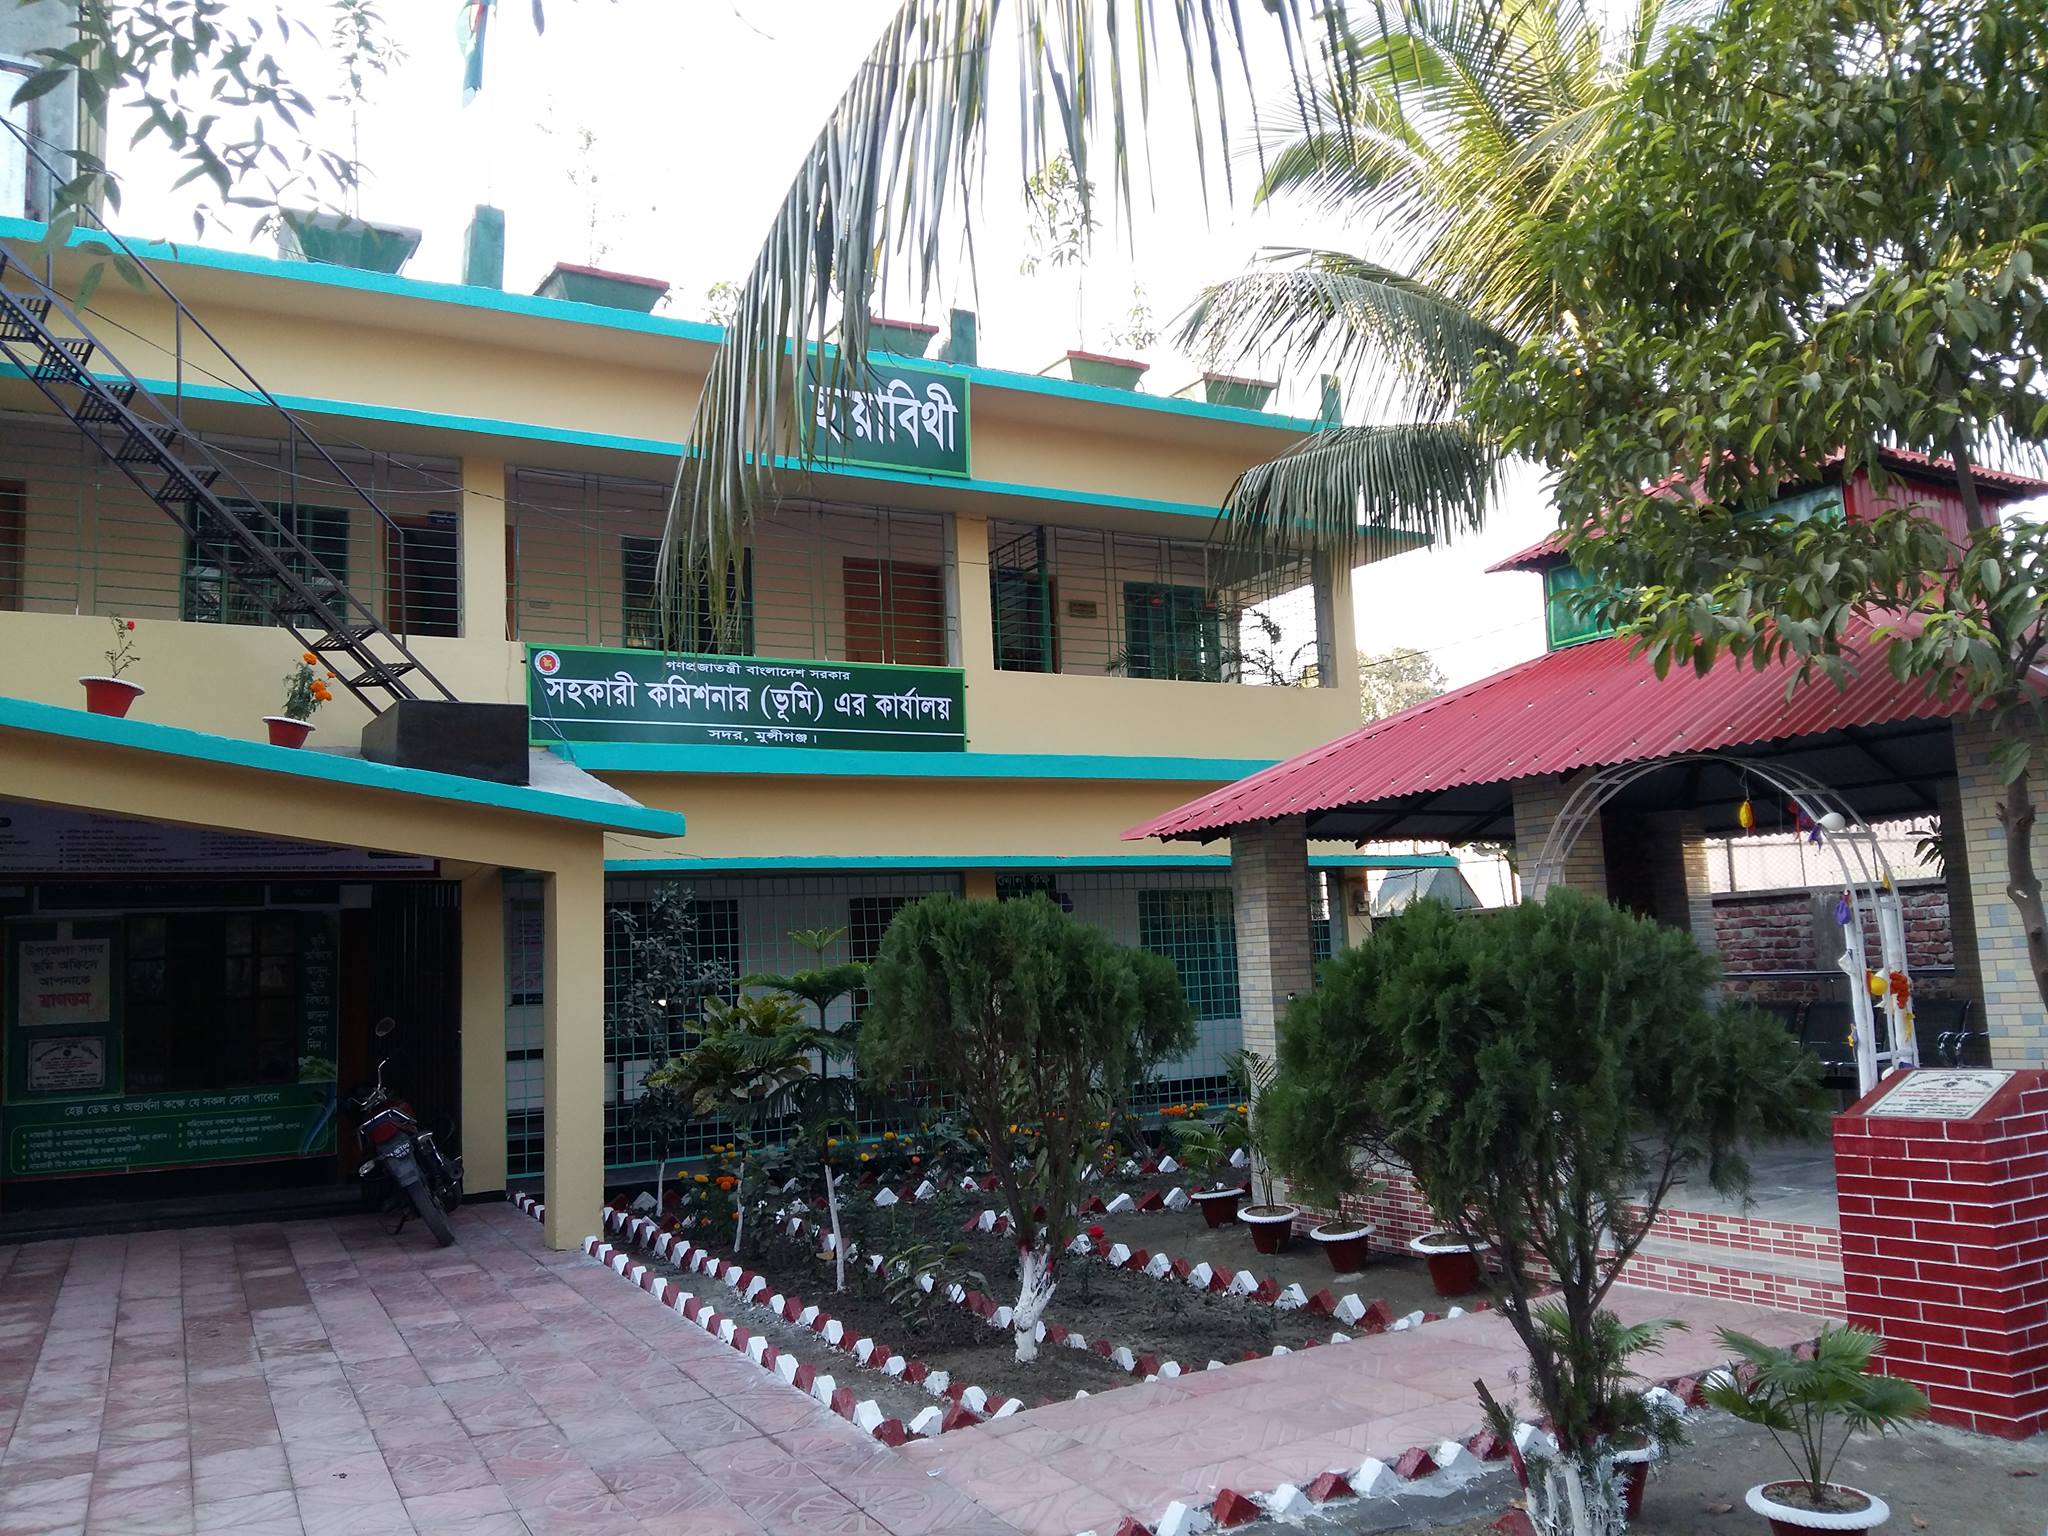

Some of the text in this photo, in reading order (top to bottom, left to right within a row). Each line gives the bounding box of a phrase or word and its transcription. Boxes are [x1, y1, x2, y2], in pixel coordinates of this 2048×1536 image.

[666, 661, 851, 681] গণপ্রজাতন্ত্রী বাংলাদেশ সরকার
[544, 671, 952, 722] সহকারী কমিশনার (ভূমি) এর কার্যালয়
[707, 729, 749, 743] সদর,
